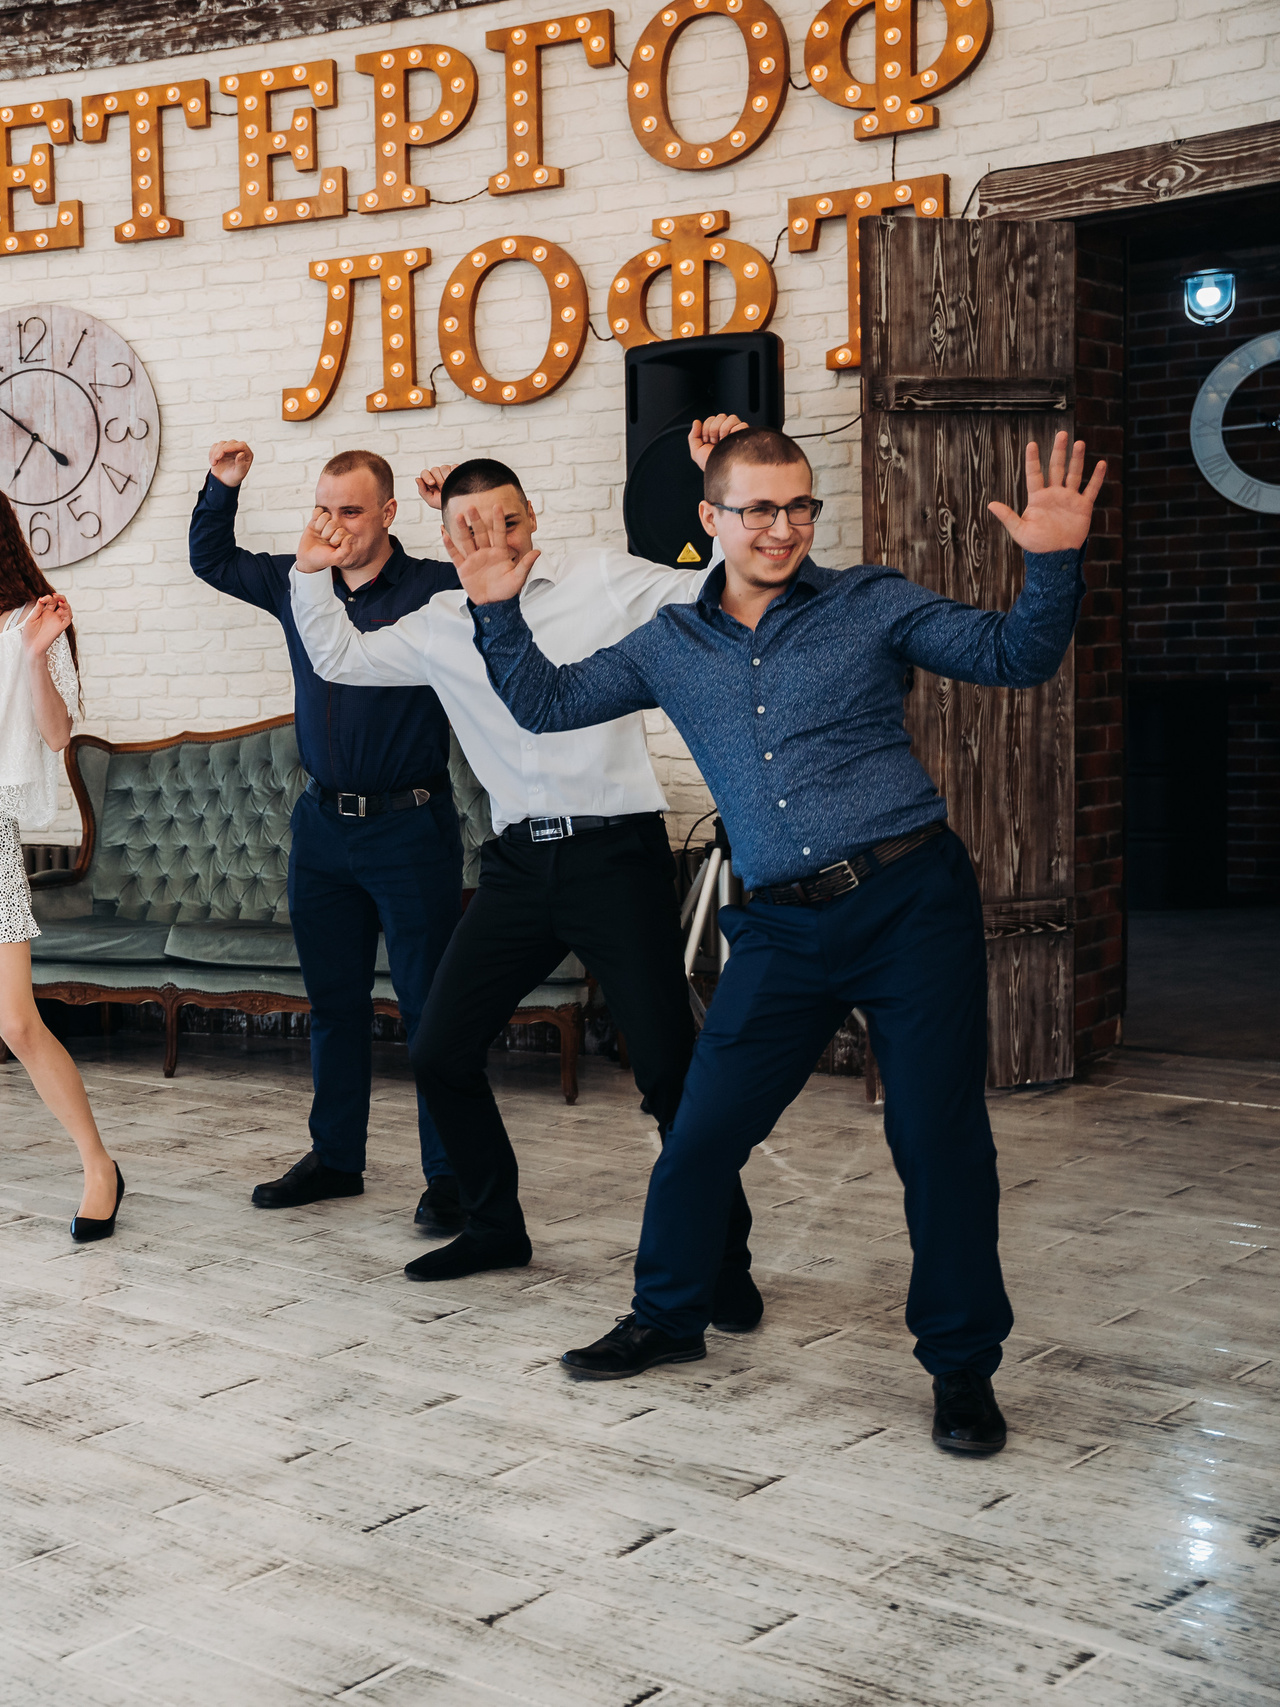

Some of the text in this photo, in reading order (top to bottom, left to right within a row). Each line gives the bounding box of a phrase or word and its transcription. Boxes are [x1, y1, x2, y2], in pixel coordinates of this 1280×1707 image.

[18, 316, 47, 364] 12
[67, 328, 88, 368] 1
[89, 362, 133, 403] 2
[104, 417, 149, 443] 3
[101, 462, 138, 495] 4
[29, 511, 51, 555] 6
[67, 494, 102, 539] 5
